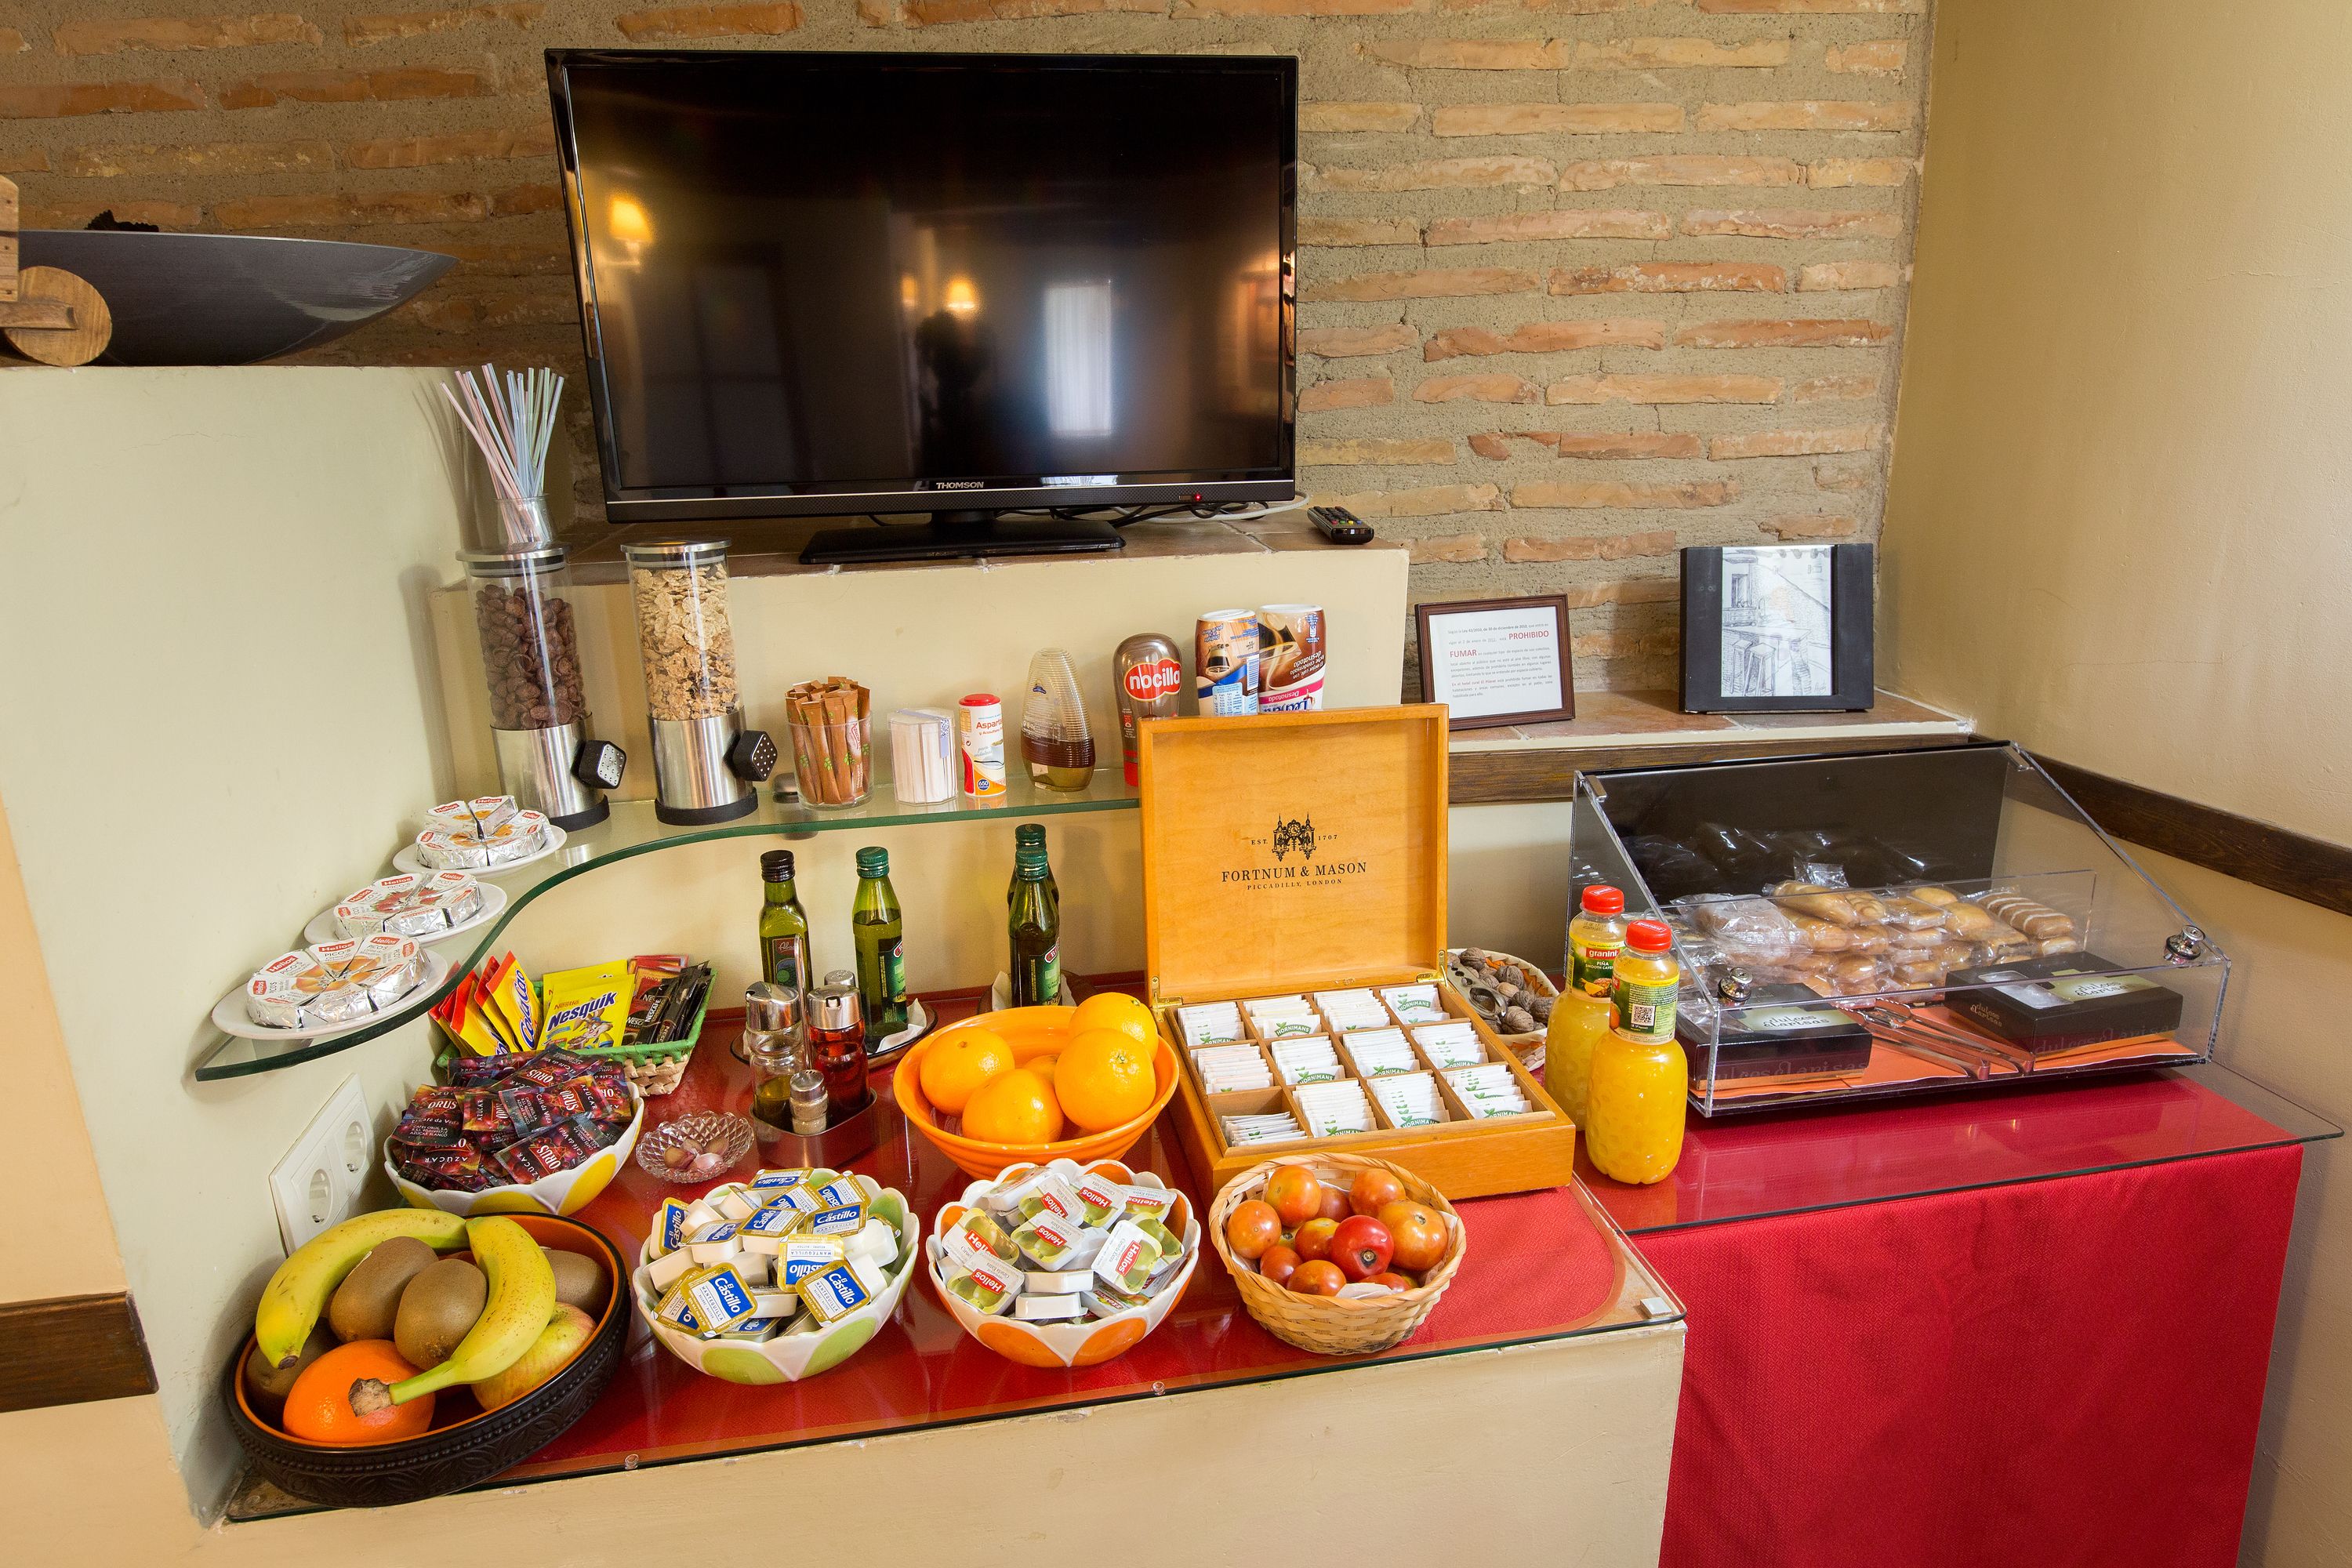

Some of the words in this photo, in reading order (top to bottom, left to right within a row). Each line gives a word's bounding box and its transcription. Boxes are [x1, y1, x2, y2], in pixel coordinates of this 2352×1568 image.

[1509, 630, 1549, 640] PROHIBIDO
[1450, 649, 1477, 658] FUMAR
[1129, 666, 1181, 690] nocilla
[1269, 691, 1299, 702] Desnatada
[436, 804, 459, 813] Helios
[1221, 866, 1295, 882] FORTNUM
[1300, 866, 1310, 877] &
[1316, 862, 1367, 877] MASON
[1247, 881, 1301, 890] PICCADILLY,
[321, 942, 354, 952] Helios
[325, 949, 351, 957] PICO'S
[269, 956, 297, 971] Helios
[255, 981, 266, 994] Helios
[546, 992, 617, 1032] Nesquik
[1399, 1000, 1429, 1011] HORNIMANS
[1277, 1025, 1310, 1036] HORNIMANS
[527, 1069, 554, 1083] ORUS
[1300, 1074, 1334, 1084] HORNIMANS
[428, 1100, 457, 1109] ORUS
[560, 1091, 579, 1111] ORUS
[581, 1084, 597, 1109] AZÚCAR
[558, 1127, 569, 1139] Vida
[537, 1145, 561, 1170] ORUS
[572, 1145, 583, 1156] Café
[517, 1152, 540, 1181] AZÚCAR
[823, 1189, 839, 1207] astillo
[1045, 1195, 1064, 1218] Helios
[1082, 1189, 1109, 1207] Helios
[1129, 1196, 1158, 1207] Helios
[753, 1210, 776, 1229] Castillo
[817, 1210, 857, 1223] Castillo
[670, 1210, 681, 1248] Castillo
[1038, 1228, 1063, 1247] Helios
[1119, 1244, 1139, 1274] Helios
[829, 1273, 854, 1305] Castillo
[975, 1272, 1001, 1292] Helios
[702, 1286, 723, 1320] MANTEQUILLA
[714, 1277, 740, 1313] Castillo
[816, 1282, 839, 1312] MANTEQUILLA
